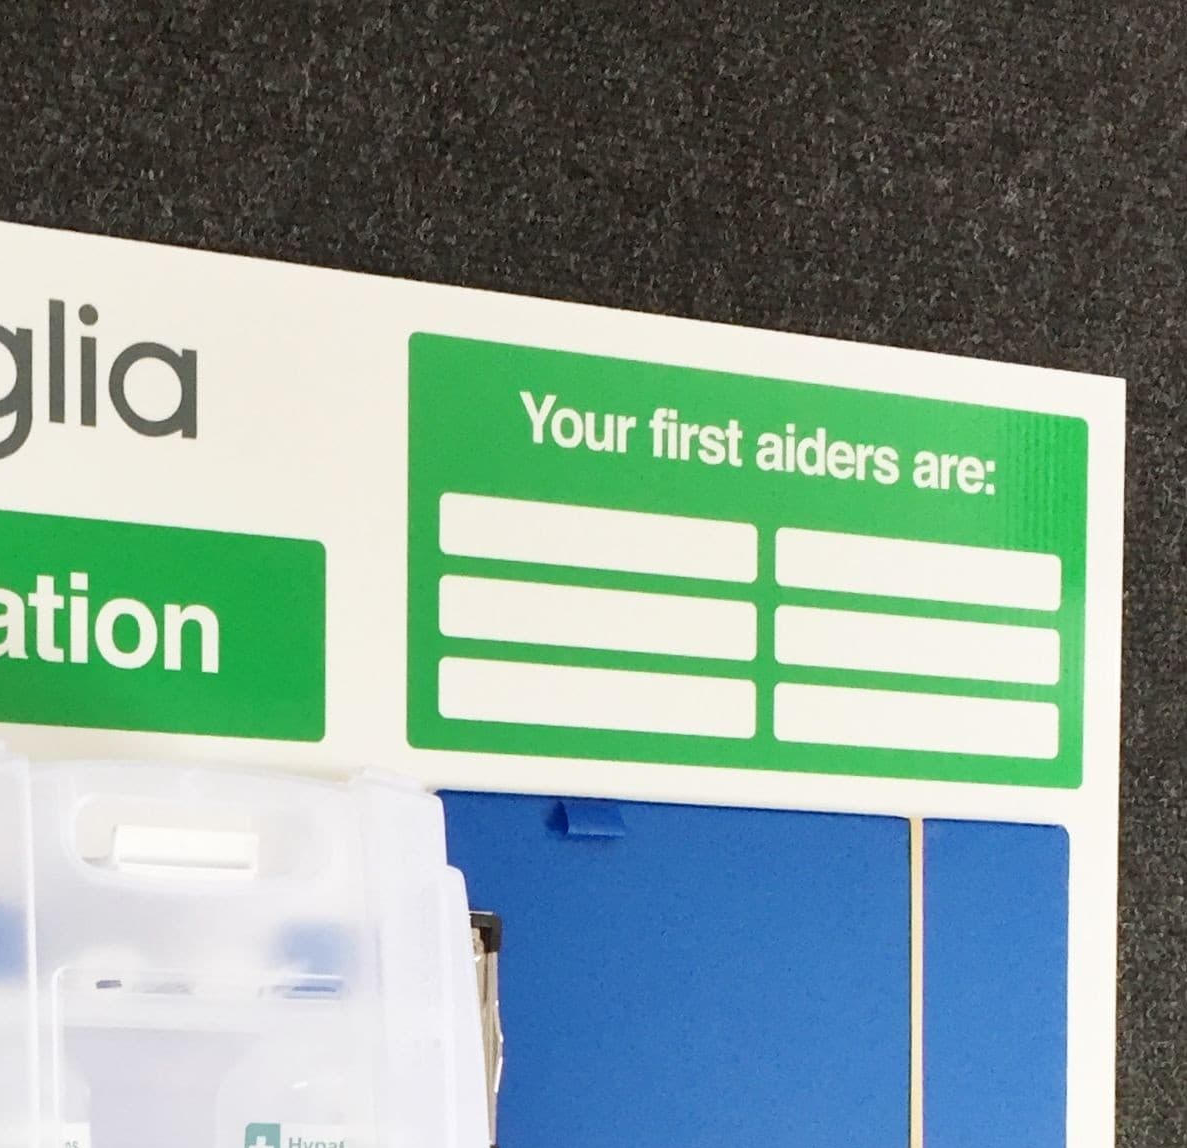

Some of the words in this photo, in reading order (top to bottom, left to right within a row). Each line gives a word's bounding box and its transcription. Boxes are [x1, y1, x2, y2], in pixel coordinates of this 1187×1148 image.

[519, 390, 637, 455] Your
[649, 408, 743, 469] first
[755, 423, 900, 486] aiders
[912, 450, 996, 495] are:
